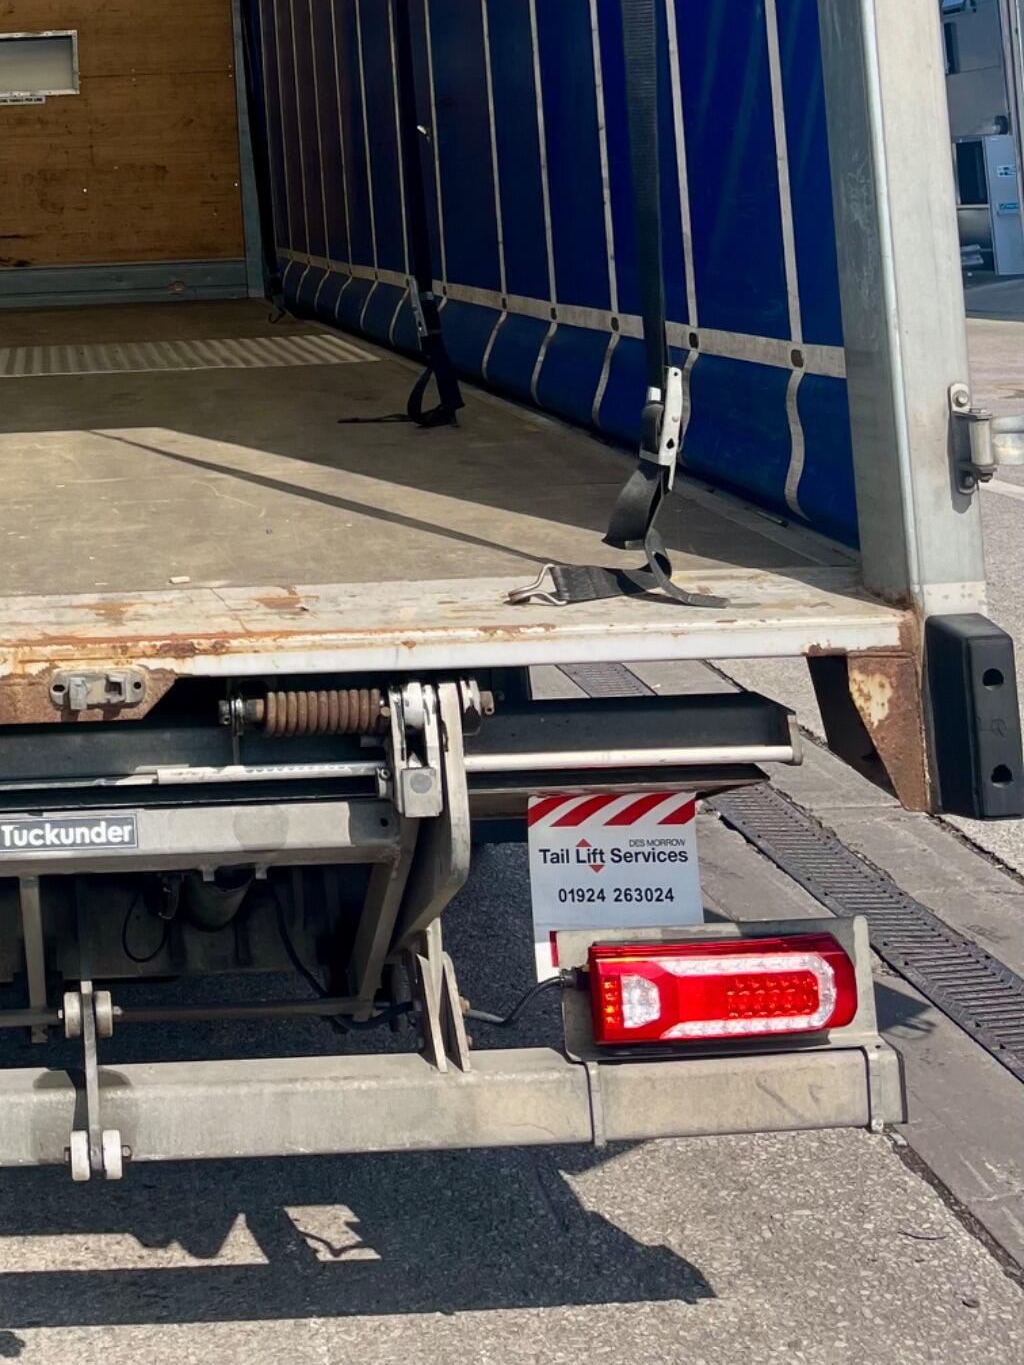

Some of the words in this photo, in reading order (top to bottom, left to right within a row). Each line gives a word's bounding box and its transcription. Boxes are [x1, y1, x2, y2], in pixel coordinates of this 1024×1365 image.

[0, 821, 132, 847] Tuckunder
[629, 839, 645, 847] DES
[646, 838, 686, 847] MORROW
[539, 848, 570, 864] Tail
[576, 848, 606, 863] Lift
[610, 847, 689, 863] Services
[558, 888, 606, 903] 01924
[613, 887, 675, 903] 263024
